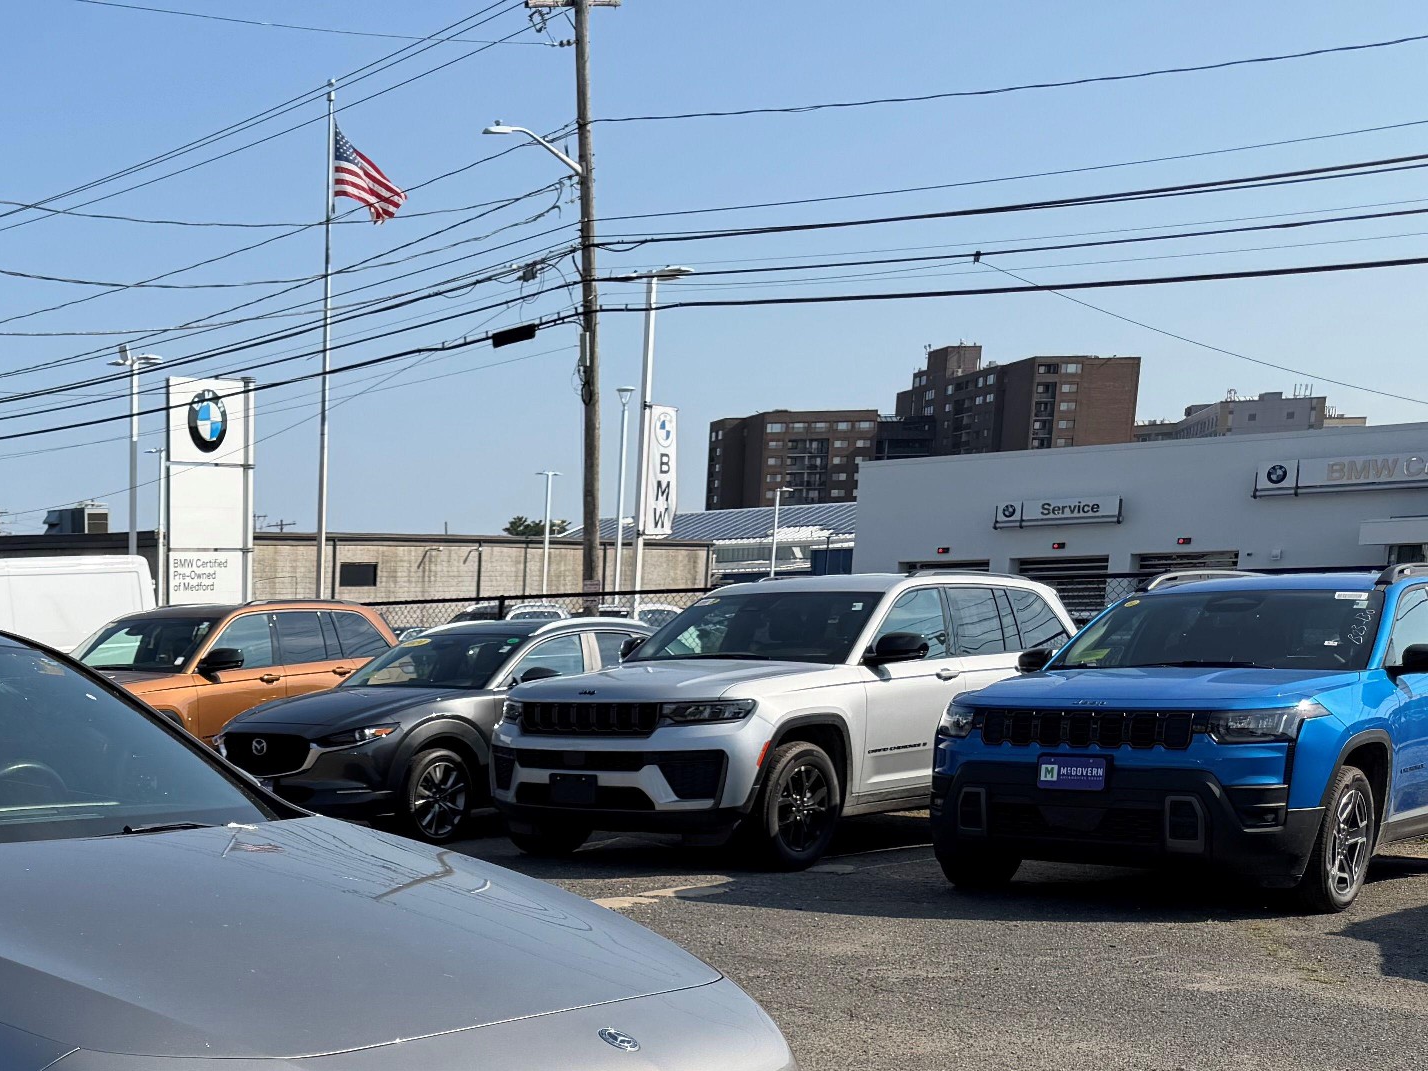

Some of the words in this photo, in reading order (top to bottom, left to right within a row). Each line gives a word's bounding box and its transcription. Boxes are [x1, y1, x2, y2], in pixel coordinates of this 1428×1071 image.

[1326, 457, 1400, 481] BMW
[653, 452, 671, 529] BMW
[1040, 501, 1100, 516] Service
[173, 558, 194, 568] BMW
[196, 558, 228, 568] Certified
[173, 570, 216, 580] Pre-Owned
[173, 582, 182, 592] of
[183, 582, 215, 592] Medford
